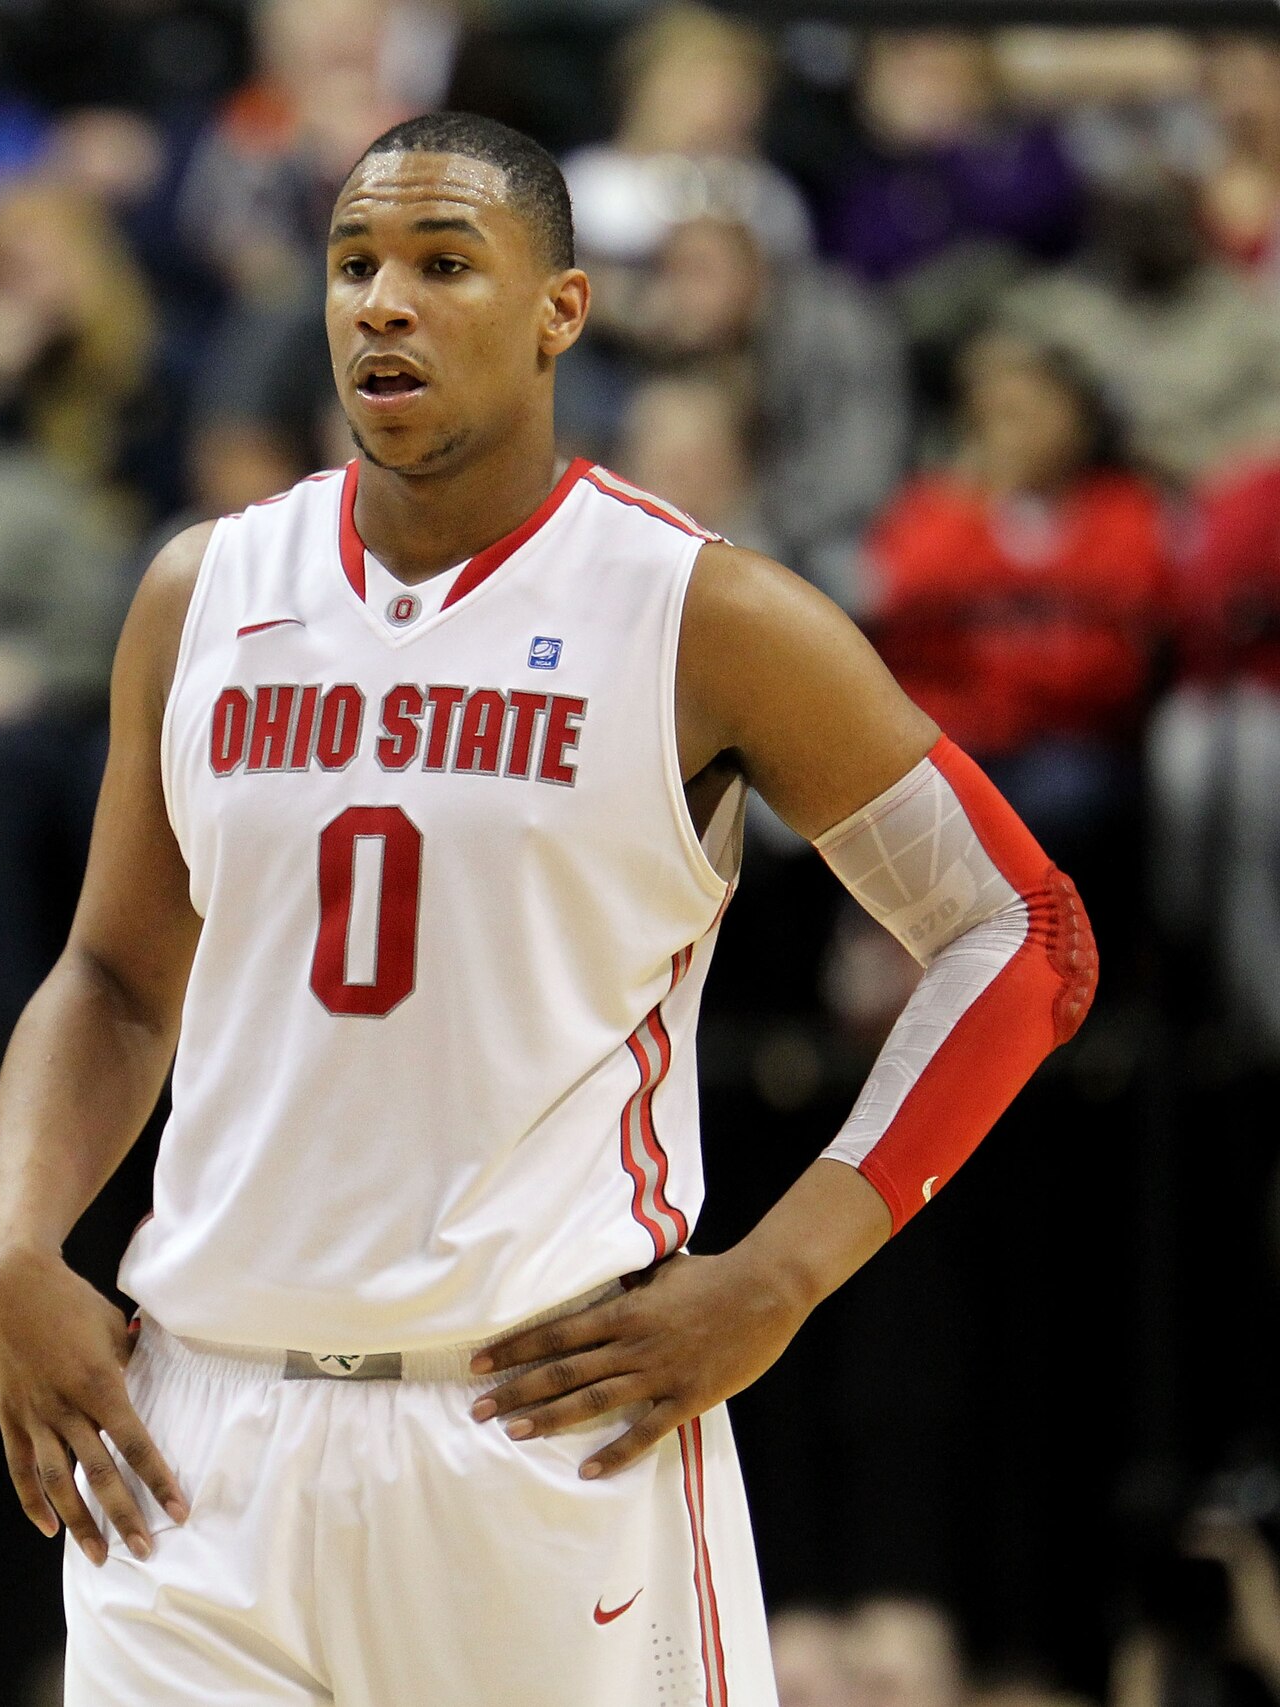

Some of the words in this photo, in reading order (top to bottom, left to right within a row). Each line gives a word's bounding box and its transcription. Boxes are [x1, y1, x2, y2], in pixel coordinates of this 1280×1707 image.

[208, 682, 365, 778] OHIO
[375, 683, 588, 788] STATE
[308, 804, 424, 1019] 0
